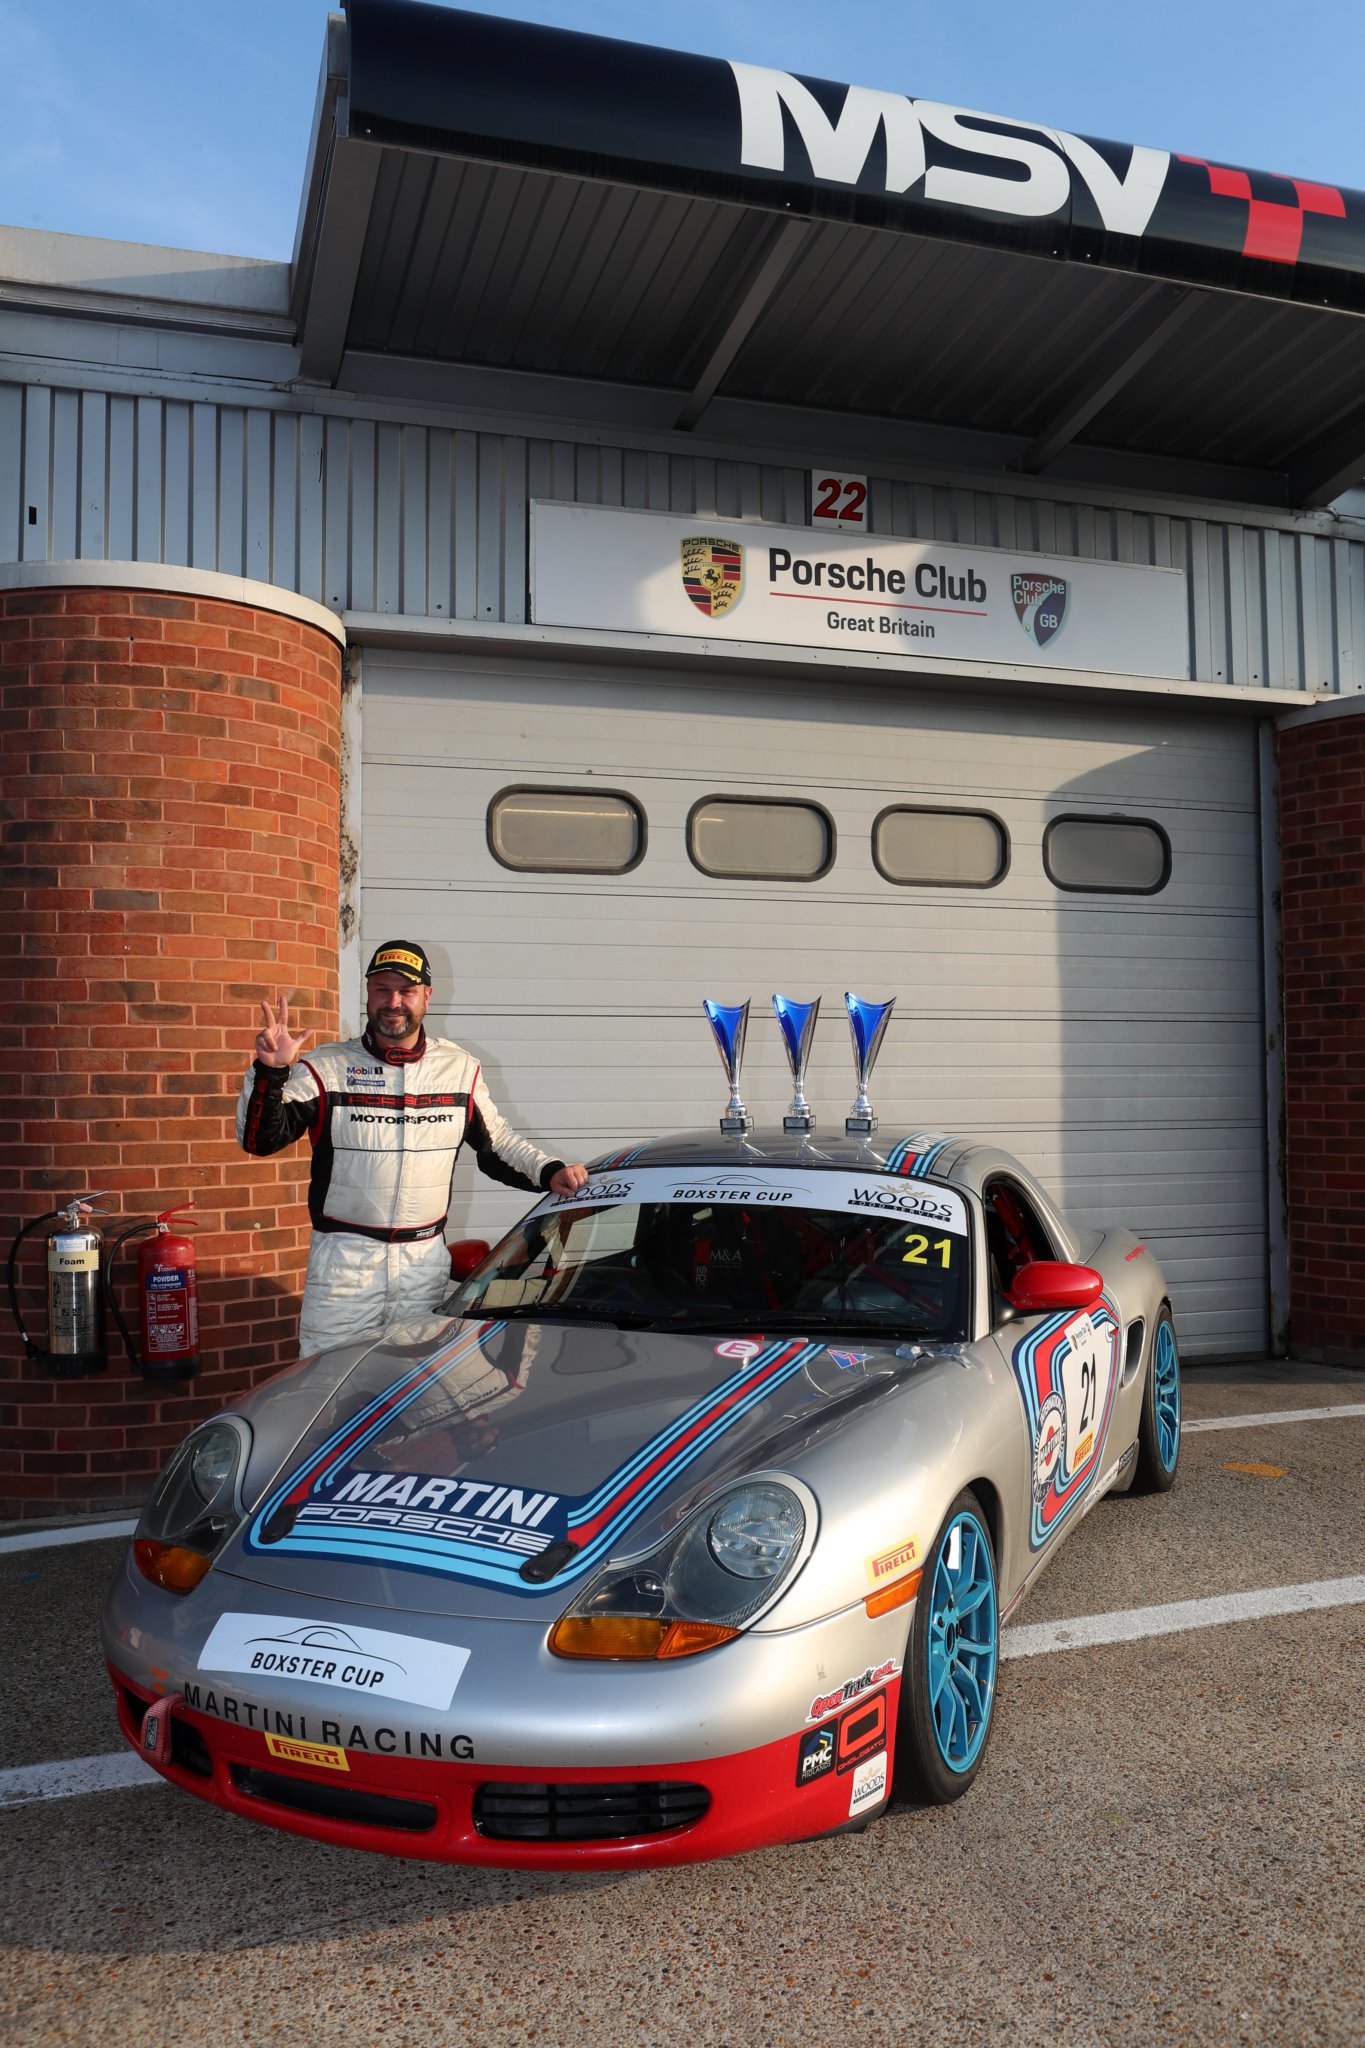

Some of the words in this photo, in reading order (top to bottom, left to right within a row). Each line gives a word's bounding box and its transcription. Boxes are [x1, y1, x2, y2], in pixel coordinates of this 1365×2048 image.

[726, 60, 1170, 236] MSV
[813, 479, 867, 522] 22
[682, 538, 741, 551] PORSCHE
[769, 548, 905, 595] Porsche
[915, 563, 987, 603] Club
[1013, 575, 1065, 595] Porsche
[1014, 590, 1043, 606] Club
[827, 612, 875, 633] Great
[880, 616, 936, 638] Britain
[1039, 613, 1058, 629] GB
[379, 951, 419, 967] PIRELLI
[347, 1067, 373, 1075] Mobil
[349, 1095, 456, 1107] PORSCHE
[350, 1114, 455, 1125] MOTORSPORT
[672, 1189, 751, 1201] BOXSTER
[756, 1191, 793, 1202] CUP
[853, 1188, 953, 1217] WOODS
[59, 1257, 85, 1266] Foam
[902, 1234, 952, 1269] 21
[153, 1275, 179, 1283] POWDER
[1079, 1353, 1096, 1436] 21
[1073, 1433, 1093, 1469] PIRELLI
[332, 1473, 559, 1528] MARTINI
[298, 1506, 552, 1553] PORSCHE
[872, 1541, 916, 1577] PIRELLI
[250, 1652, 337, 1680] BOXSTER
[341, 1665, 384, 1689] CUP
[184, 1681, 307, 1739] MARTINI
[322, 1720, 475, 1760] RACING
[272, 1738, 341, 1766] PIRELLI
[803, 1746, 832, 1772] PMC
[838, 1739, 884, 1771] OMOLOGATO
[802, 1761, 831, 1780] MIDLANDS
[854, 1772, 885, 1798] WOODS
